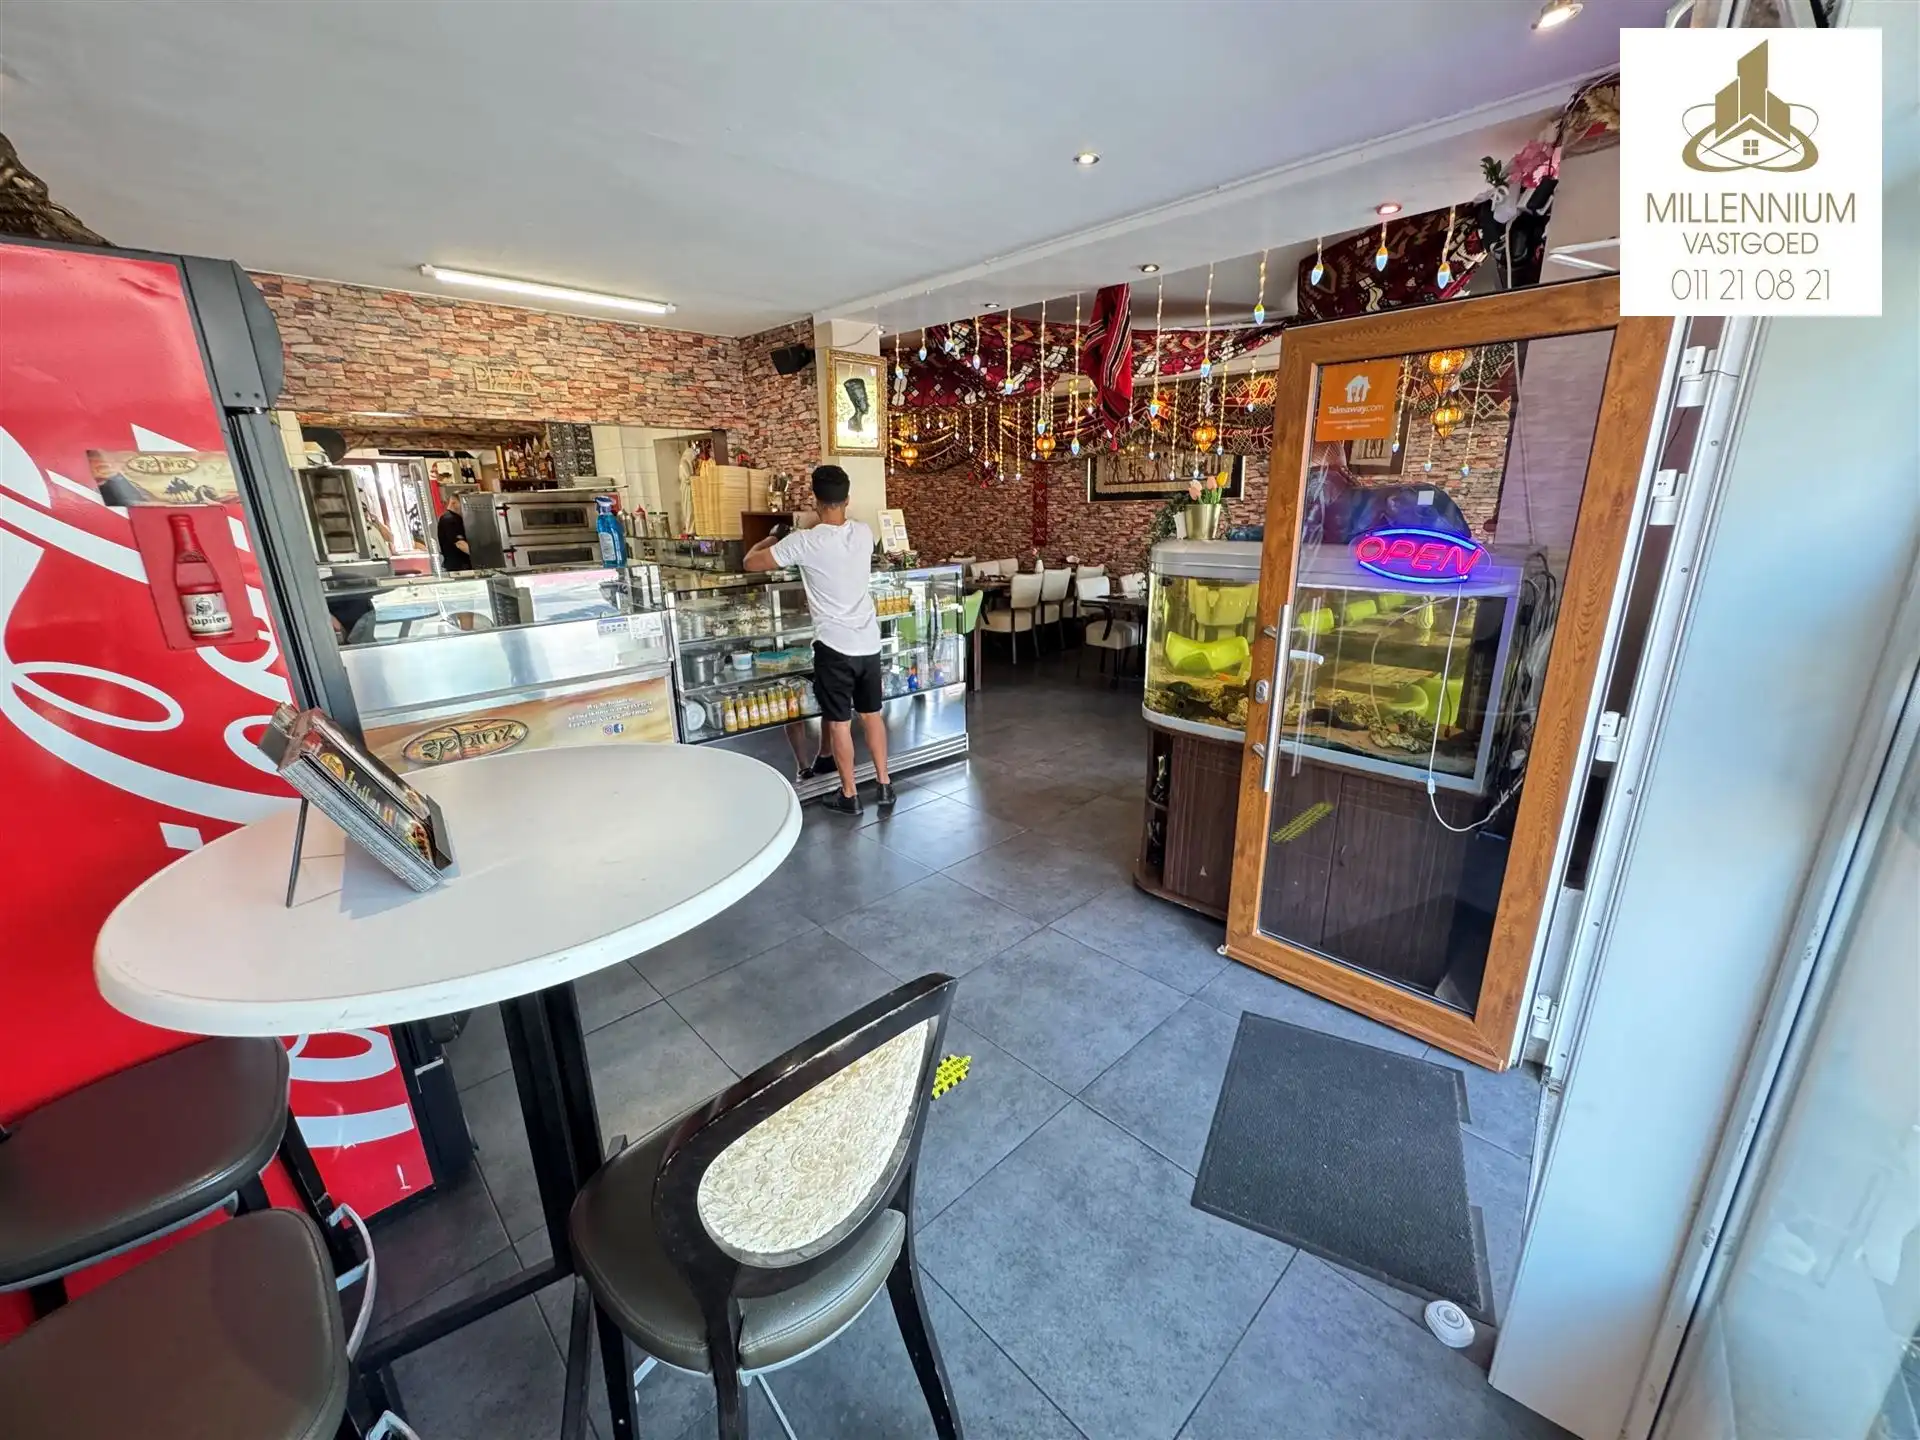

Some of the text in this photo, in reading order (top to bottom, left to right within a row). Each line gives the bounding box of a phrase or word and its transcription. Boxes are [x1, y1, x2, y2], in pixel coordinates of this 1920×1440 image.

[472, 365, 540, 394] PIZZA
[1356, 536, 1482, 575] OPEN
[189, 615, 228, 627] Jupiler
